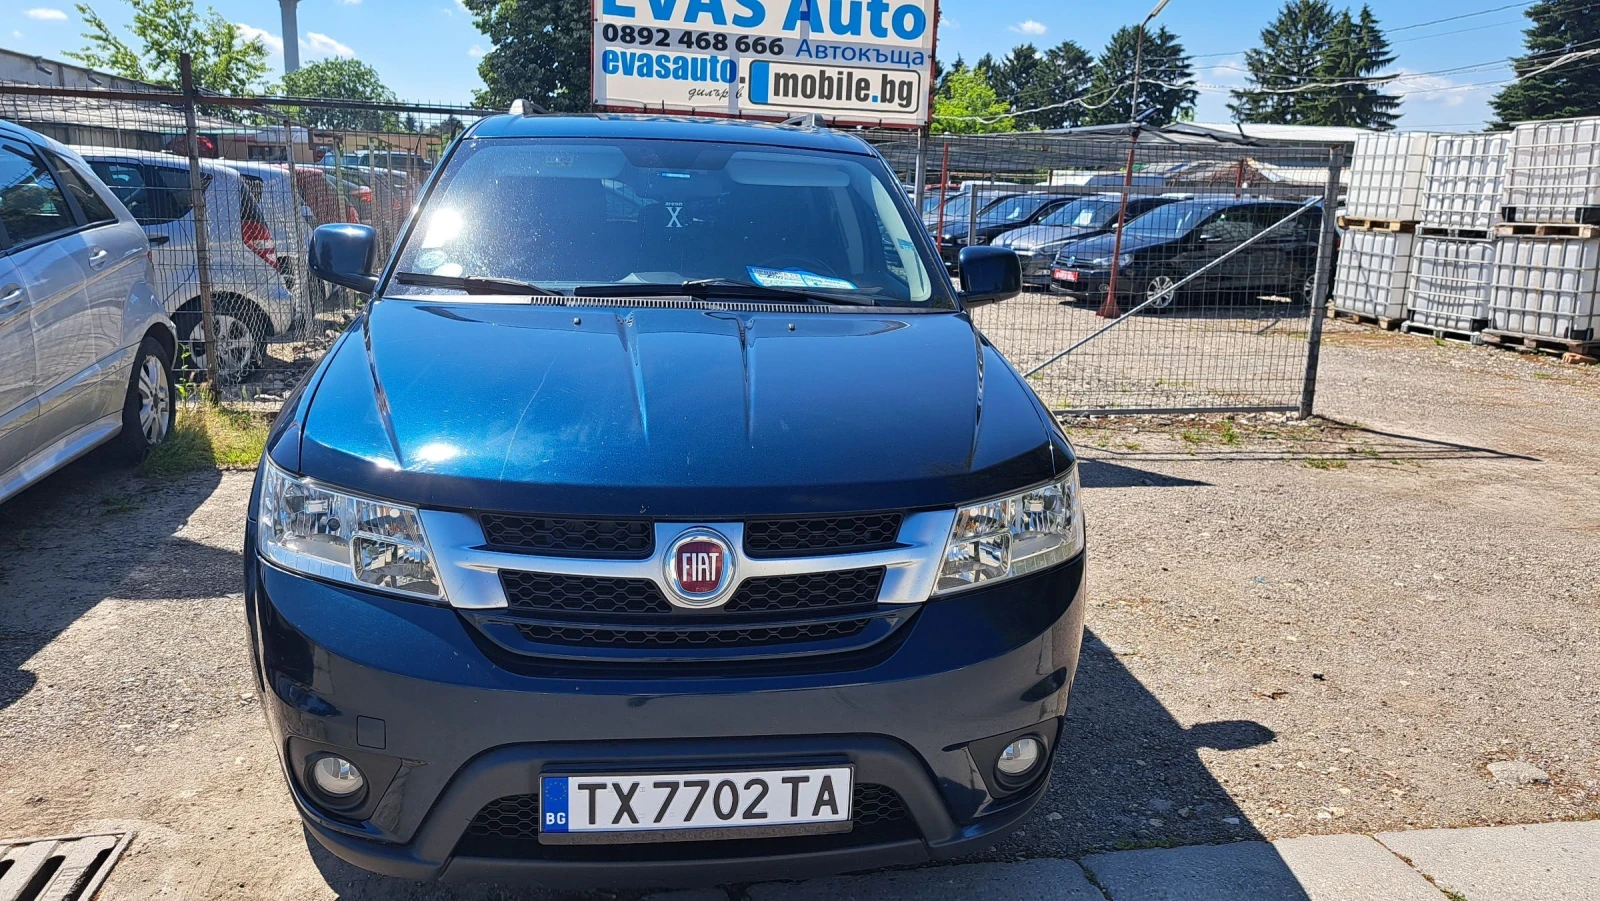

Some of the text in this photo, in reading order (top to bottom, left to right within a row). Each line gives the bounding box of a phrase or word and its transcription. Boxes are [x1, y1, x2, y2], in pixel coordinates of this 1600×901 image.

[782, 0, 926, 41] Auto
[602, 23, 784, 56] 0892 468 666
[795, 39, 924, 68] Автокъща
[773, 70, 914, 109] mobile.bg
[665, 206, 684, 228] X
[682, 552, 720, 582] FIAT
[577, 775, 840, 825] TX 7702 TA
[546, 812, 566, 825] BG
